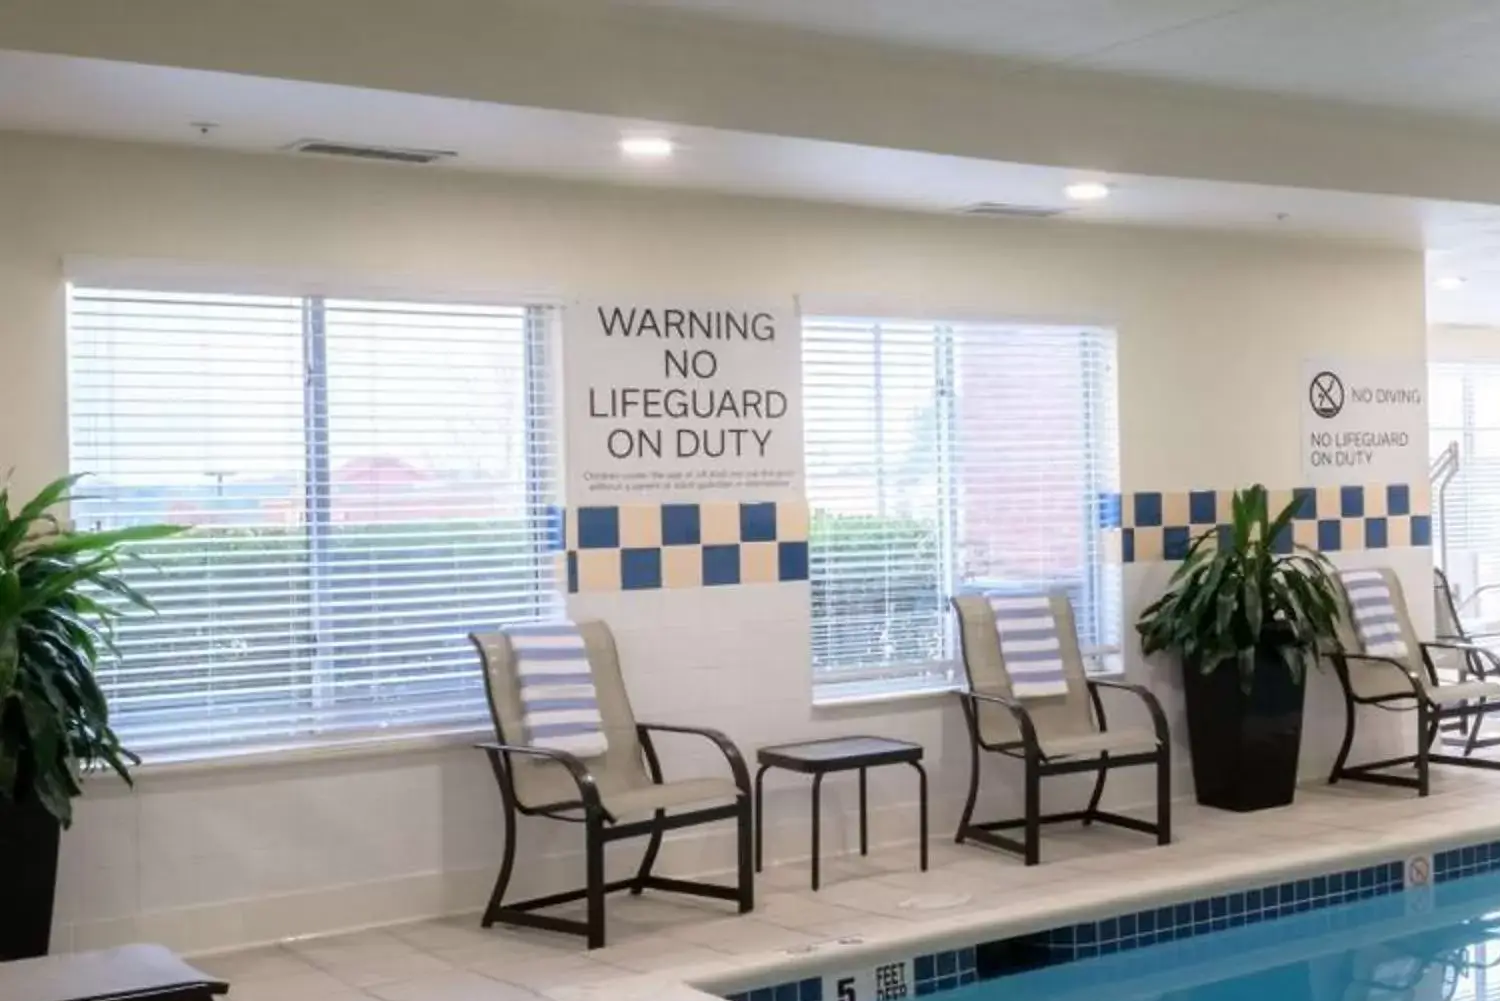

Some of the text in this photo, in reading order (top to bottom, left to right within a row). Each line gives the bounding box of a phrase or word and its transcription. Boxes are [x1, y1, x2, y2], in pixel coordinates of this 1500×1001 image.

[598, 306, 775, 341] WARNING
[664, 349, 717, 379] NO
[589, 387, 788, 418] LIFEGUARD
[1351, 387, 1421, 405] NO DIVING
[607, 428, 772, 459] ON DUTY
[1310, 431, 1408, 447] NO LIFEGUARD
[1310, 450, 1373, 467] ON DUTY
[876, 962, 906, 987] FEET
